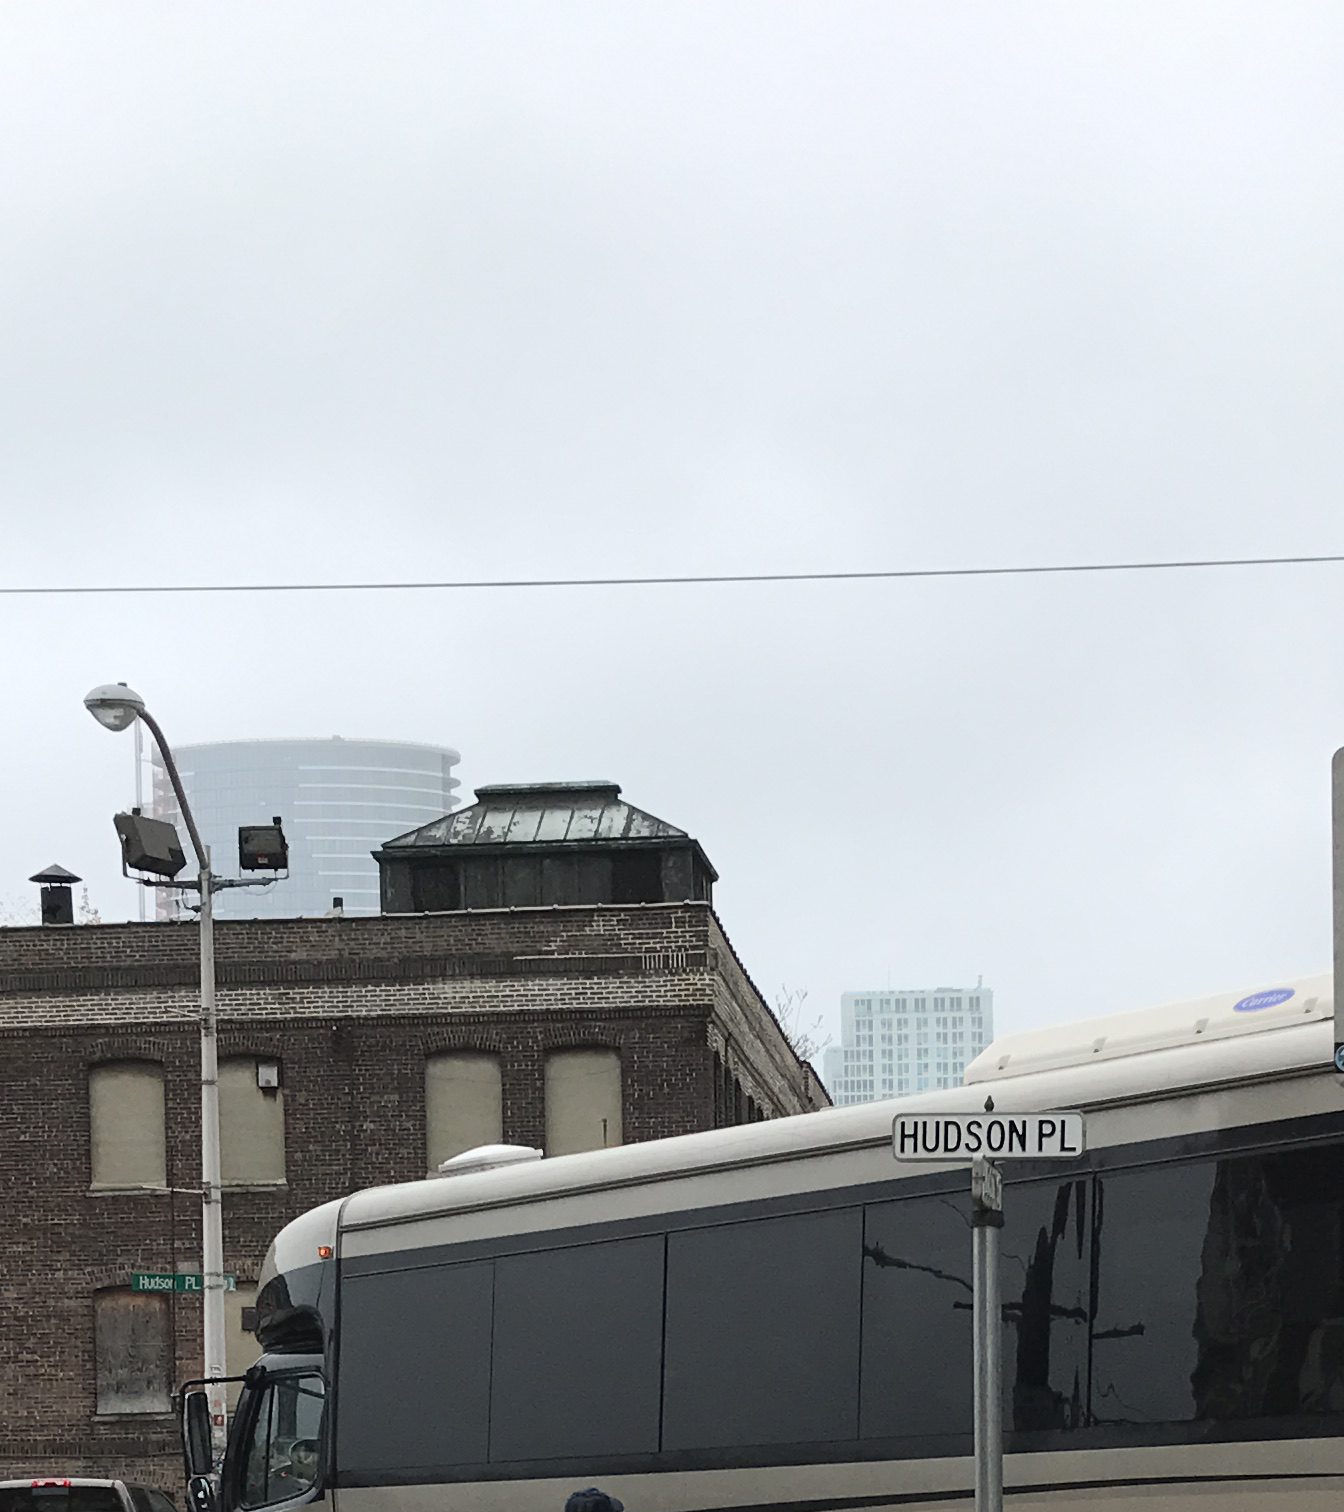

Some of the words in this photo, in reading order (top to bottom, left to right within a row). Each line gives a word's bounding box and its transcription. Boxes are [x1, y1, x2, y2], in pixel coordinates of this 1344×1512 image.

[900, 1119, 1027, 1153] HUDSON
[1038, 1119, 1077, 1153] PL
[139, 1276, 177, 1289] Hudson
